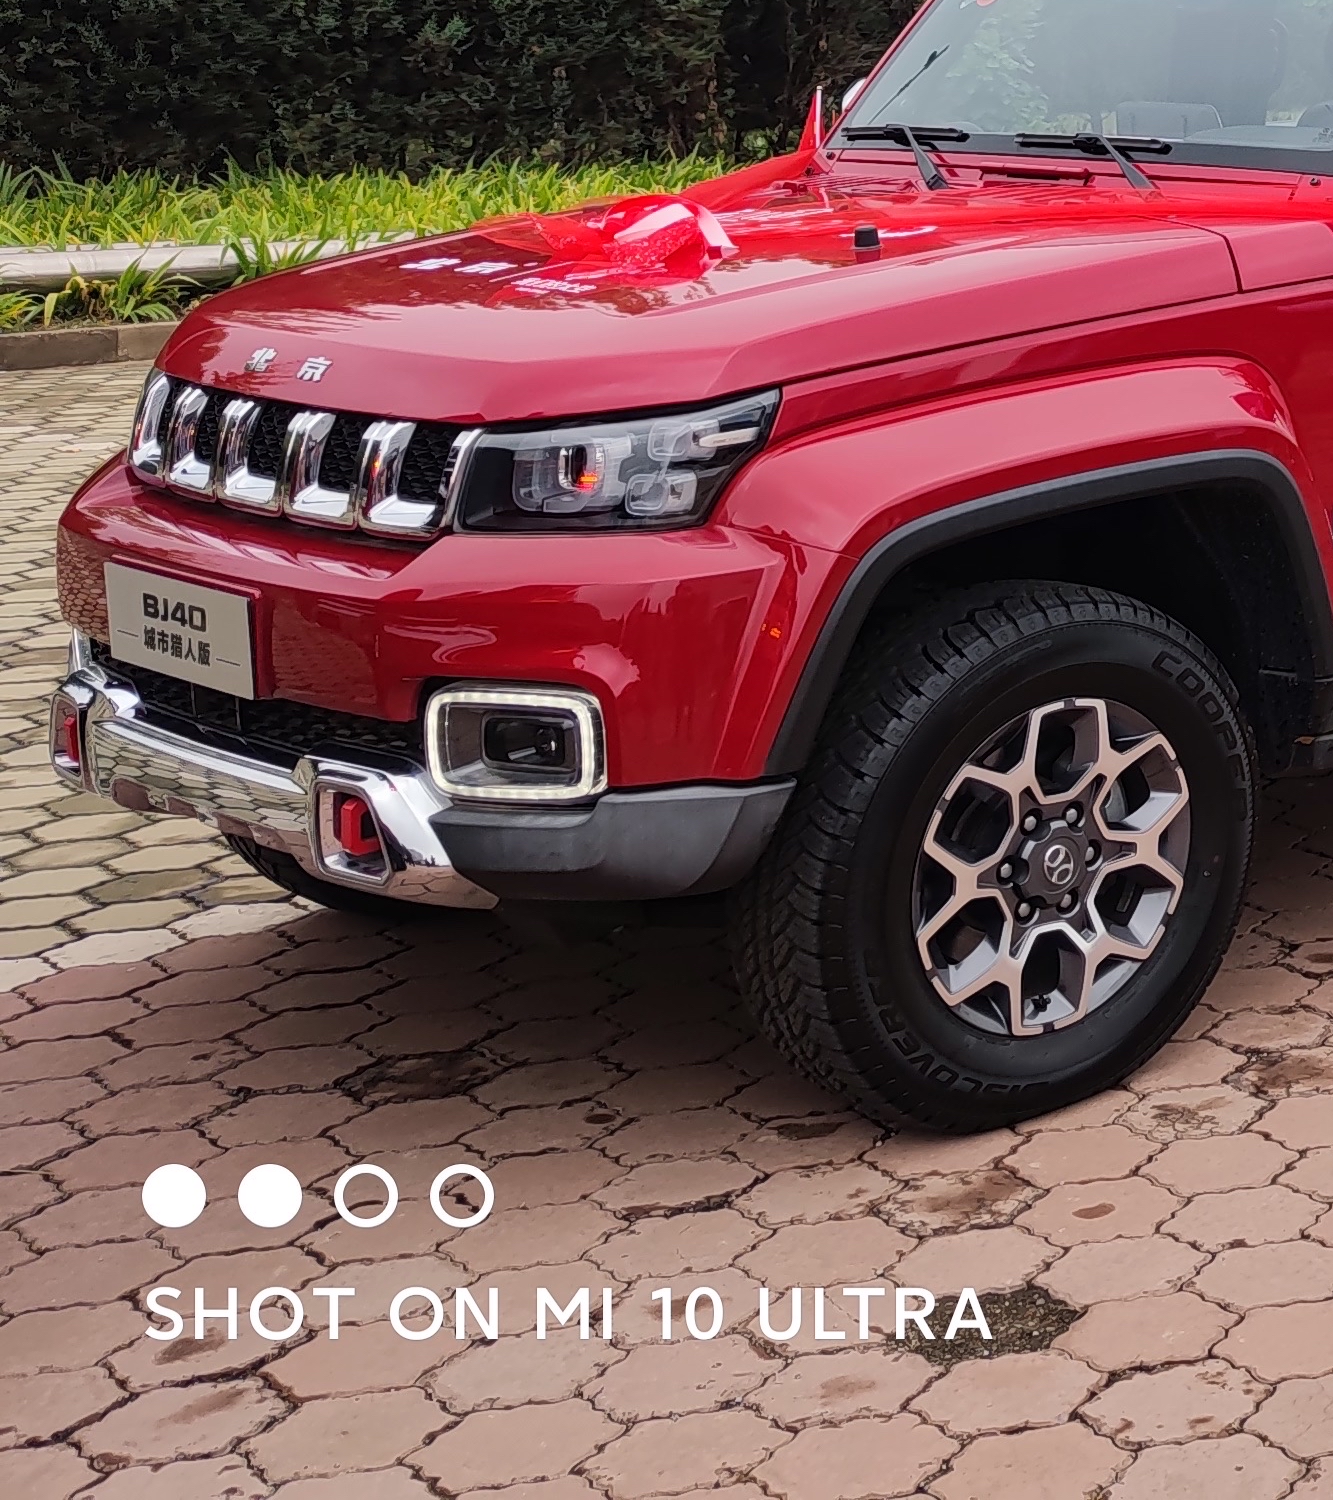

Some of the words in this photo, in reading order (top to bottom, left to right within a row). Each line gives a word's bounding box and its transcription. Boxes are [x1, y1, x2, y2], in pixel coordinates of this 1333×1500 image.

[243, 347, 334, 383] 北京
[142, 592, 207, 633] BJ40
[143, 624, 211, 668] 城市猎人版
